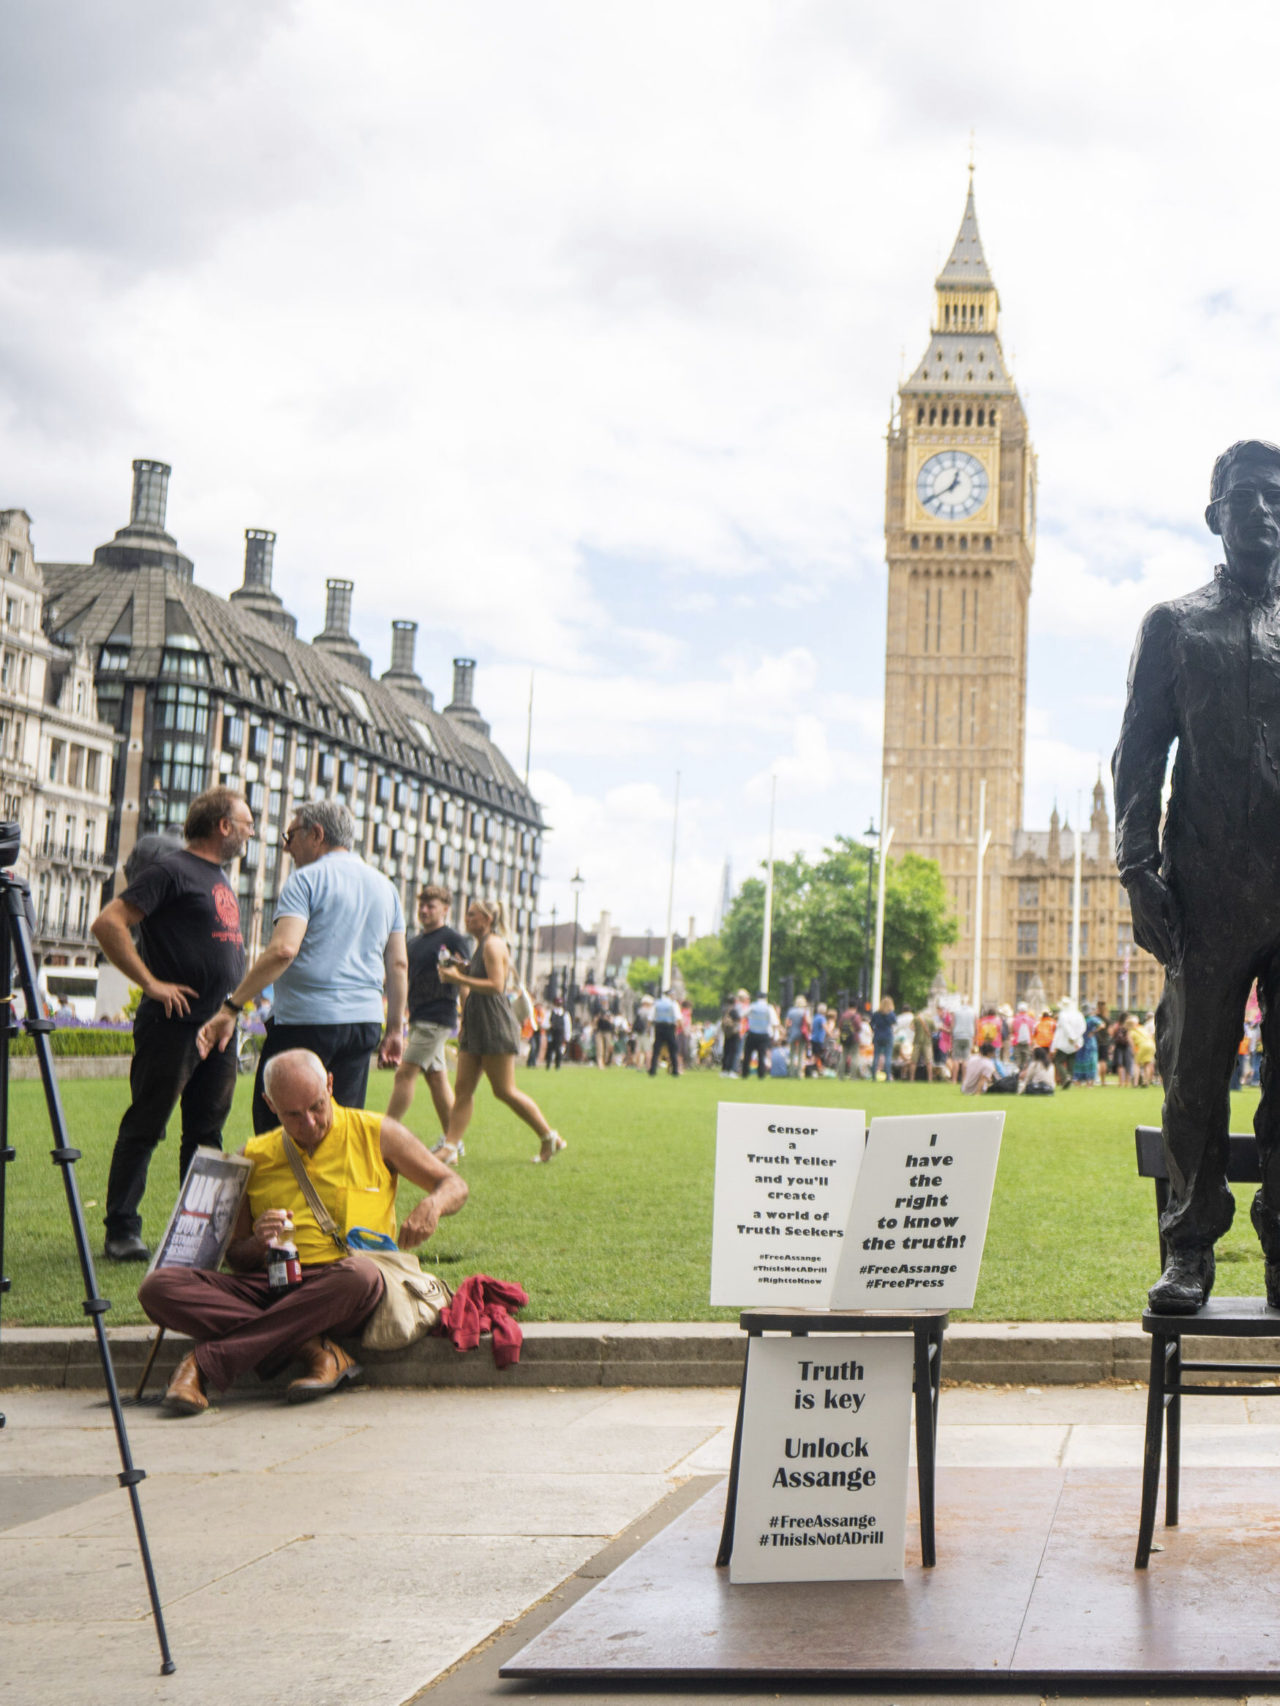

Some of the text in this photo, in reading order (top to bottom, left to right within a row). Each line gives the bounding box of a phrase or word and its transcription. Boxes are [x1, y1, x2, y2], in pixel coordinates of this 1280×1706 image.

[767, 1124, 818, 1136] Censor
[788, 1142, 797, 1150] a
[929, 1133, 938, 1147] I
[747, 1153, 837, 1167] Truth Teller
[905, 1154, 954, 1168] have
[754, 1175, 829, 1187] and you'll
[909, 1174, 943, 1188] the
[767, 1191, 816, 1201] create
[894, 1194, 949, 1211] right
[753, 1211, 829, 1221] a world of
[877, 1215, 960, 1229] to know
[737, 1224, 844, 1238] Truth Seekers
[862, 1234, 967, 1251] the truth!
[859, 1263, 957, 1275] #FreeAssange
[866, 1278, 945, 1290] #FreePress
[798, 1361, 864, 1381] Truth
[794, 1389, 866, 1413] is key
[785, 1437, 869, 1458] Unlock
[772, 1467, 876, 1491] Assange
[769, 1514, 876, 1529] #FreeAssange
[759, 1531, 884, 1546] #ThisIsNotADrill
